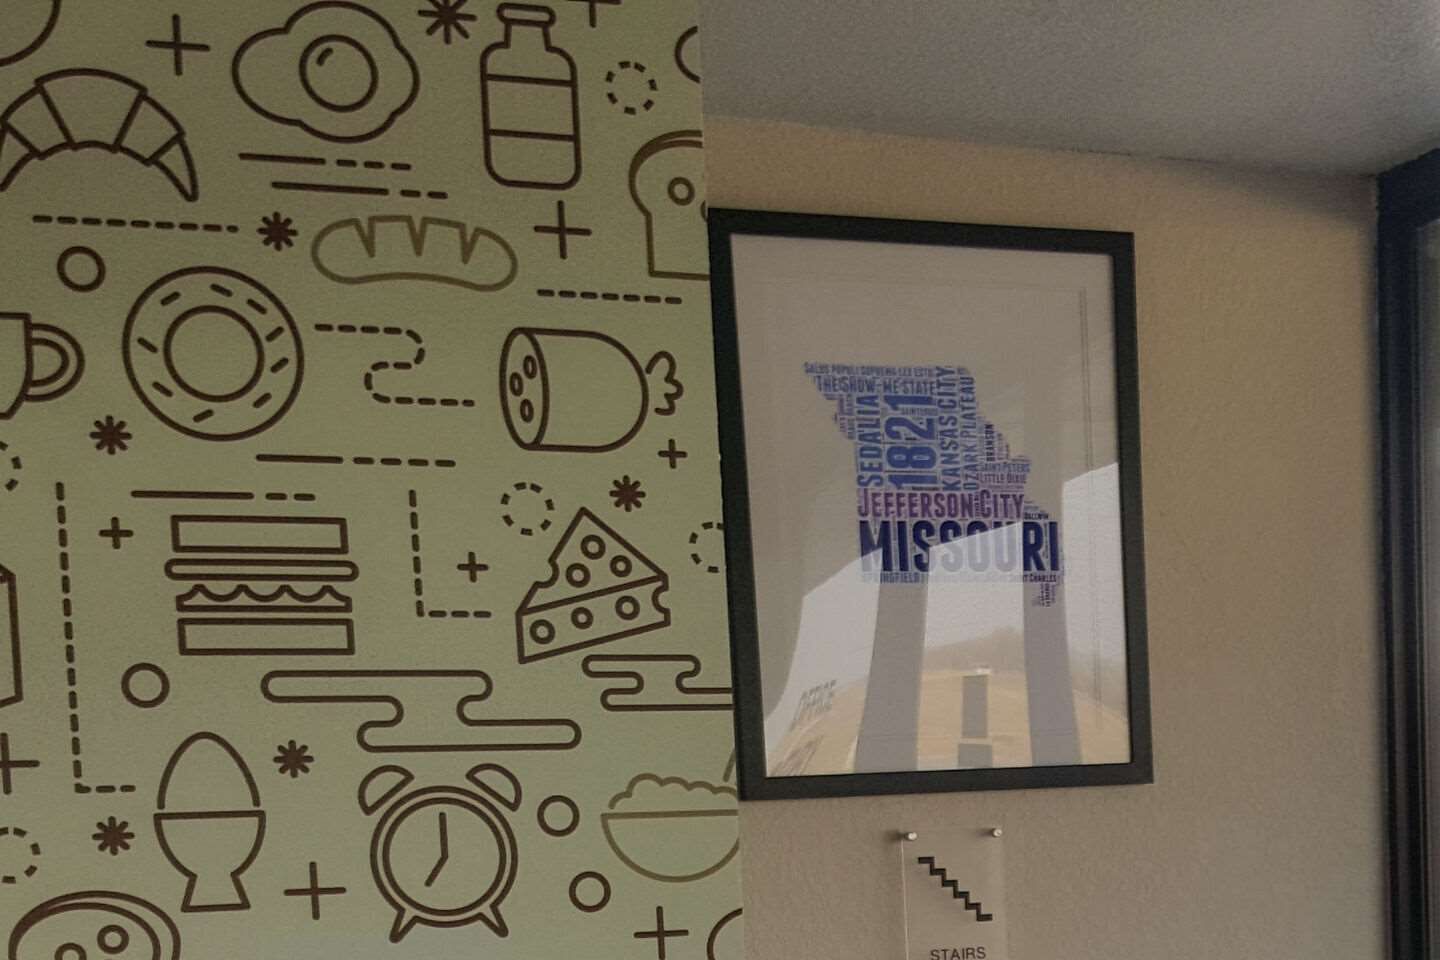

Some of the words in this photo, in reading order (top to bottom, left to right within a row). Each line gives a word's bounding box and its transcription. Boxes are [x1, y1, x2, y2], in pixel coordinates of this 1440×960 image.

[902, 379, 935, 394] STATE
[935, 366, 957, 413] CITY
[959, 376, 977, 440] PLATEAU
[856, 395, 884, 488] SEDALIA
[884, 395, 938, 490] 1821
[938, 415, 961, 491] KANSAS
[961, 442, 979, 491] OZARK
[857, 489, 973, 518] JEFFERSON
[980, 488, 1025, 518] CITY
[860, 520, 1060, 573] MISSOURI
